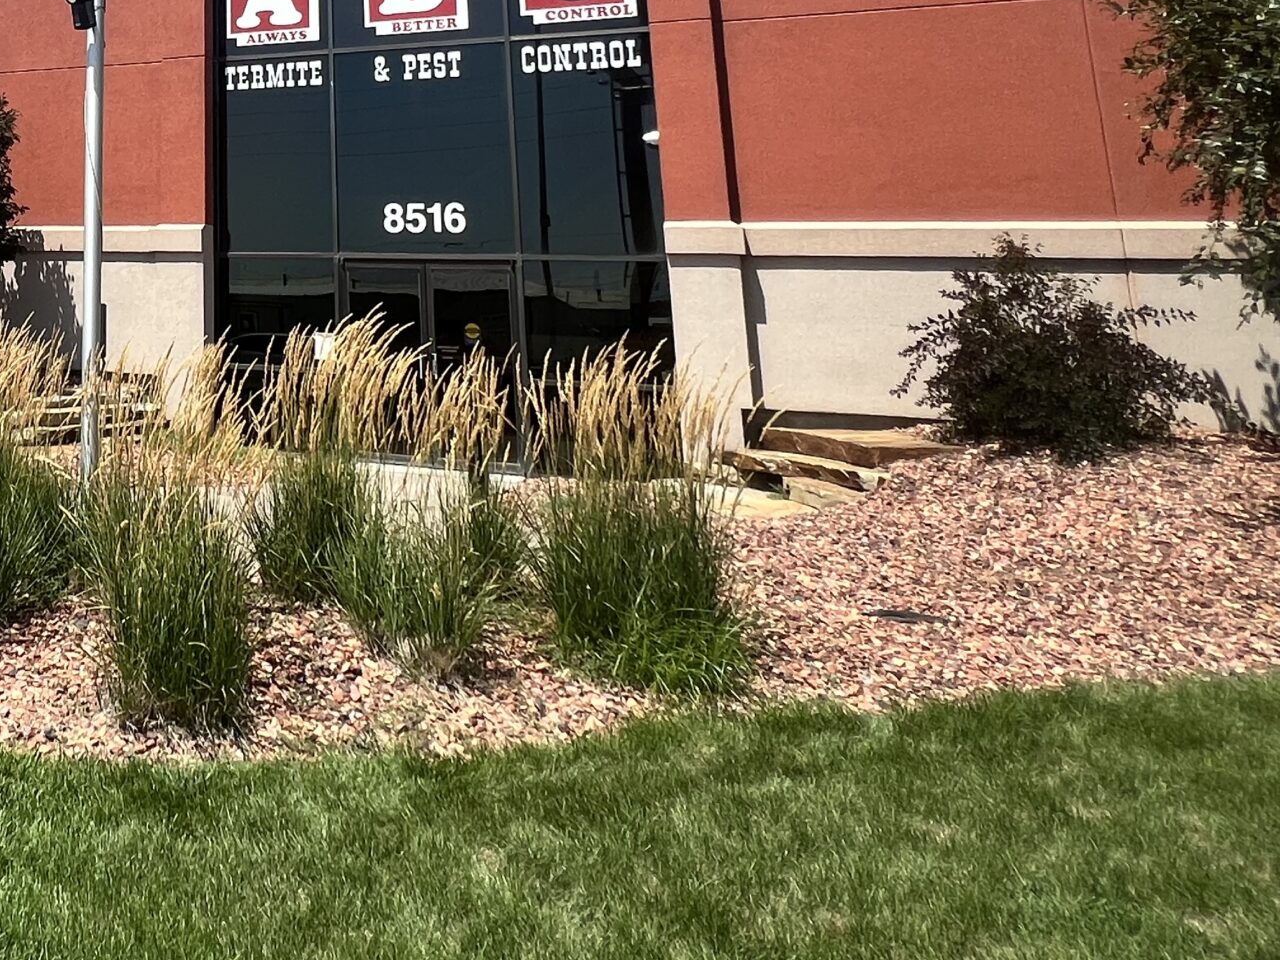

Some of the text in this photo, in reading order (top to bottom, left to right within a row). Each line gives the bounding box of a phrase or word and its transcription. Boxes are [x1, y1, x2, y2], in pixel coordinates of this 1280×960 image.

[545, 4, 634, 22] CONTROL
[391, 17, 458, 33] BETTER
[246, 30, 308, 44] ALWAYS
[225, 40, 642, 91] TERMITE & PEST CONTROL
[383, 202, 467, 234] 8516
